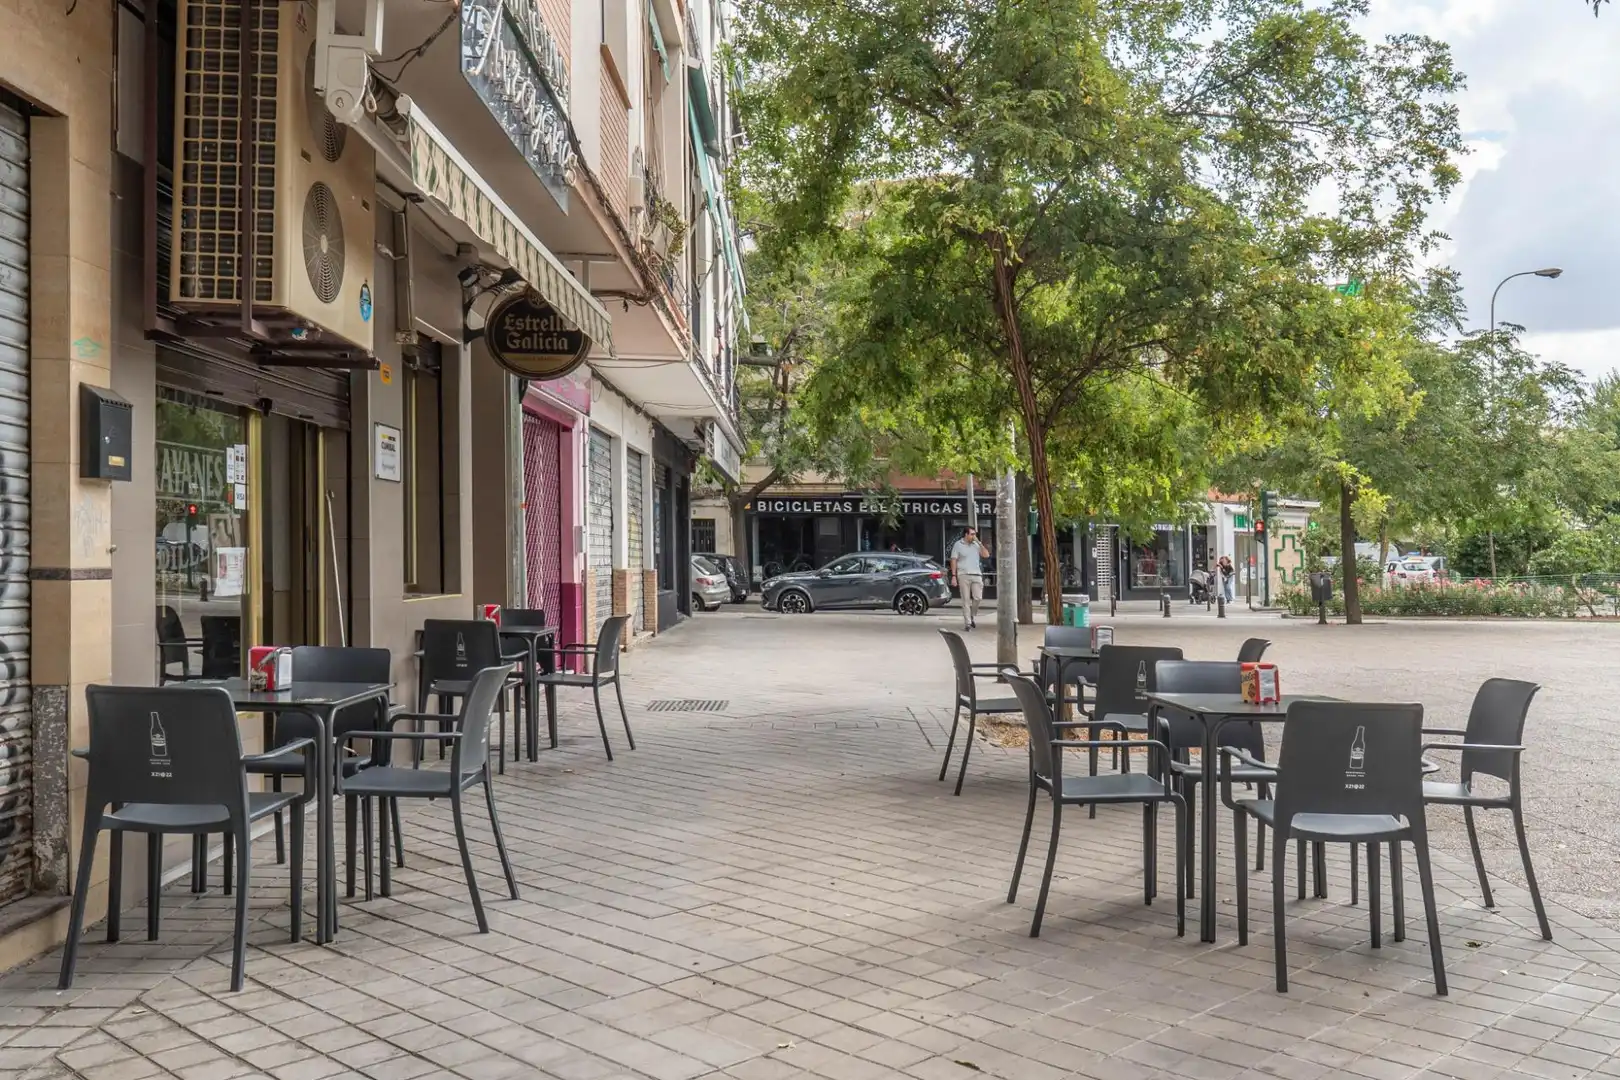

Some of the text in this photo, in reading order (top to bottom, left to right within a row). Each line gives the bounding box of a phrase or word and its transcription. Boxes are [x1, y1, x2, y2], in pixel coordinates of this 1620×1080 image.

[503, 314, 567, 332] Estrell
[506, 331, 569, 350] Galicia
[758, 501, 853, 513] BICICLETAS
